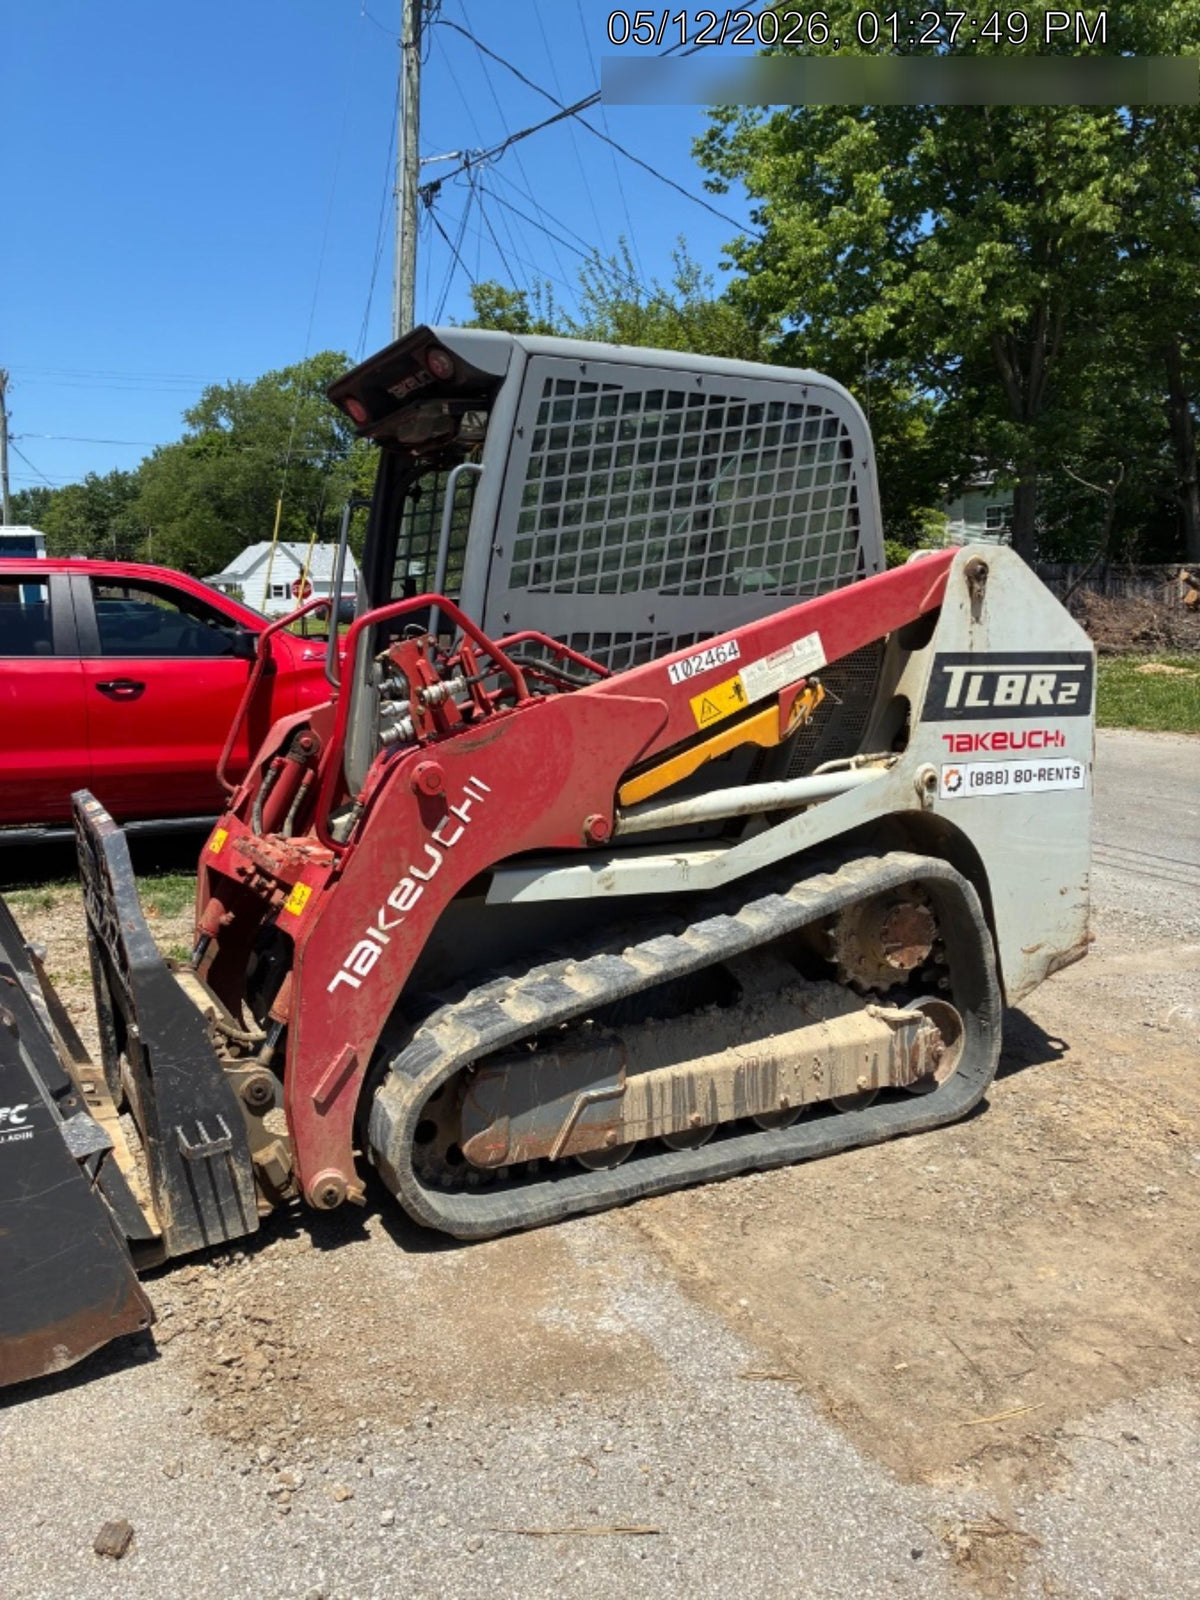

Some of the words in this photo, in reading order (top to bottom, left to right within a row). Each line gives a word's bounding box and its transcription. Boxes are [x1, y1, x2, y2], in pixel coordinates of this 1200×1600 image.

[670, 640, 739, 683] 102464
[943, 664, 1086, 708] TL8R2
[942, 729, 1066, 753] TAKEUCHI
[970, 771, 1009, 788] (888)
[1013, 765, 1081, 783] 80-RENTS
[327, 775, 492, 993] TAKEUCHI
